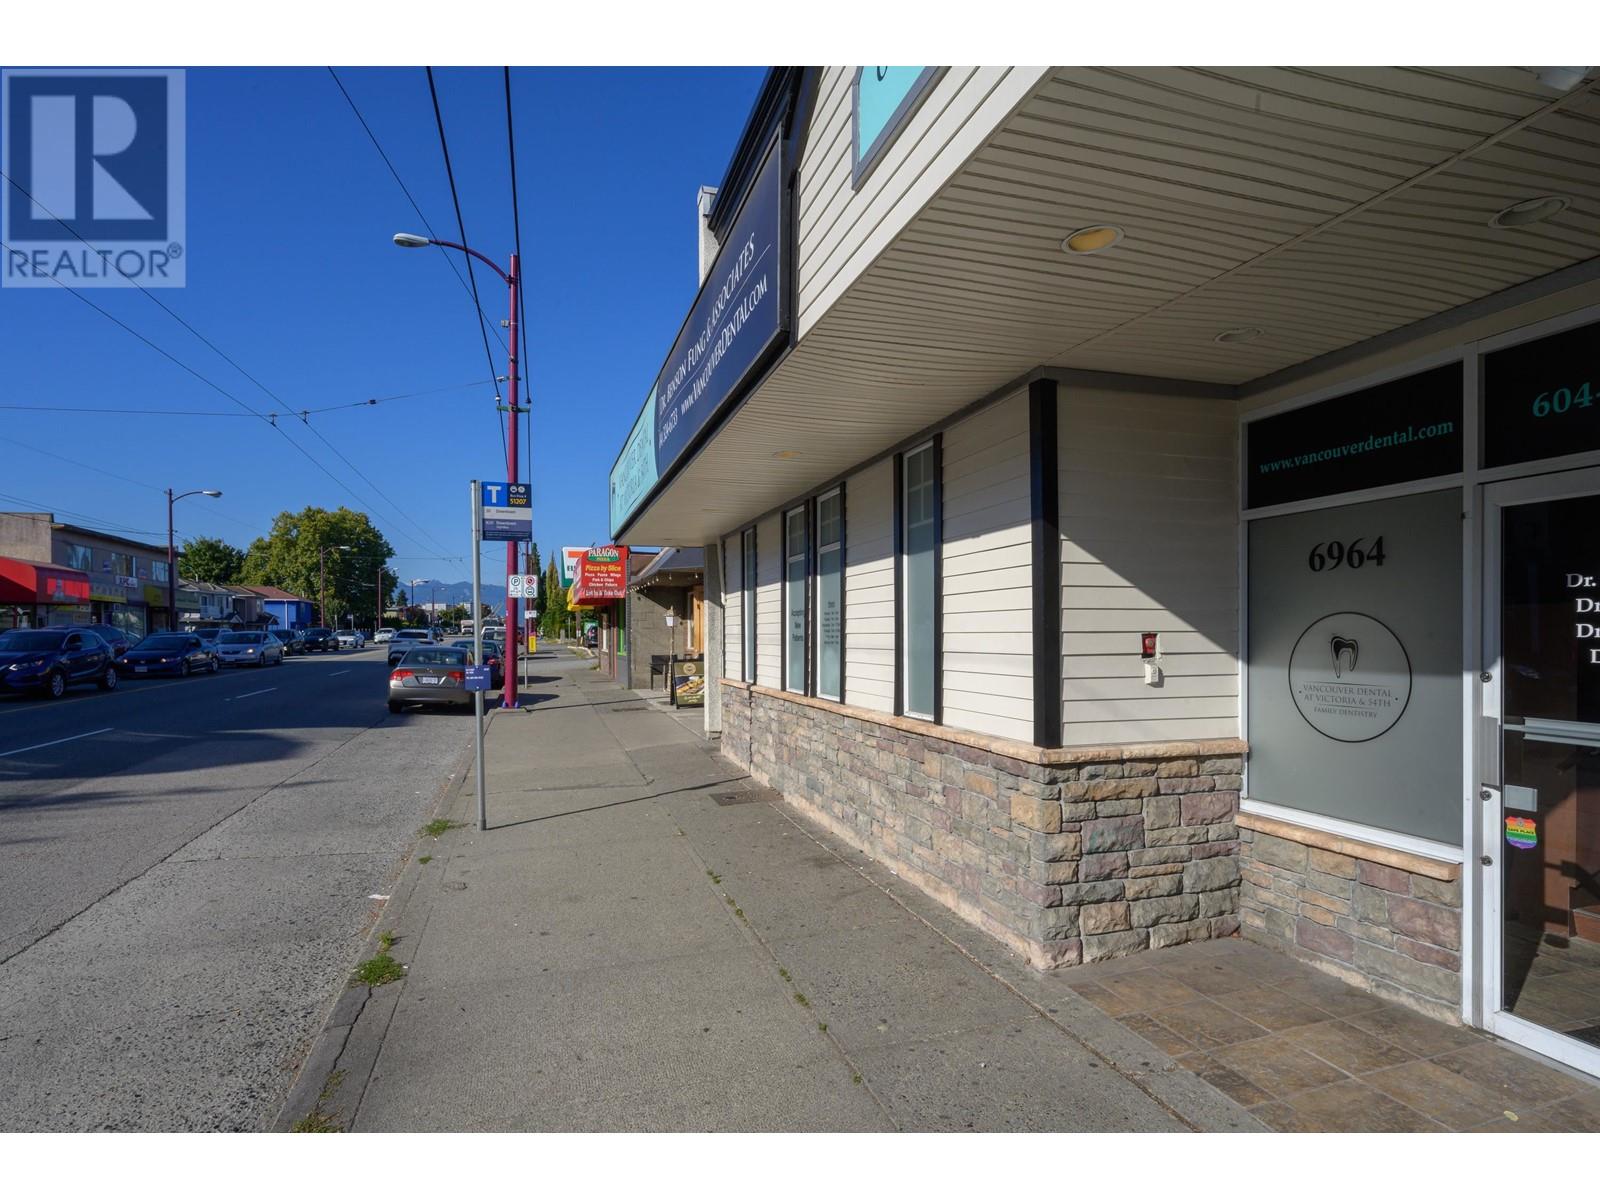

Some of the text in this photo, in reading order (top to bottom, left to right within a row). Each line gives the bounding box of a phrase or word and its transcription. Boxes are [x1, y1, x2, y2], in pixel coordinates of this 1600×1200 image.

[687, 330, 706, 372] FUNG
[706, 317, 713, 342] &
[712, 232, 755, 327] ASSOCIATES
[1259, 421, 1454, 474] www.vancouverdental.com
[487, 485, 502, 504] T
[588, 547, 619, 557] PARAGON
[1308, 535, 1386, 572] 6964
[1566, 573, 1597, 588] Dr.
[1303, 684, 1391, 697] VANCOUVER DENTAL
[1316, 694, 1357, 705] VICTORIA
[1369, 698, 1391, 707] 54TH
[1314, 706, 1377, 718] FAMILY DENTISTRY
